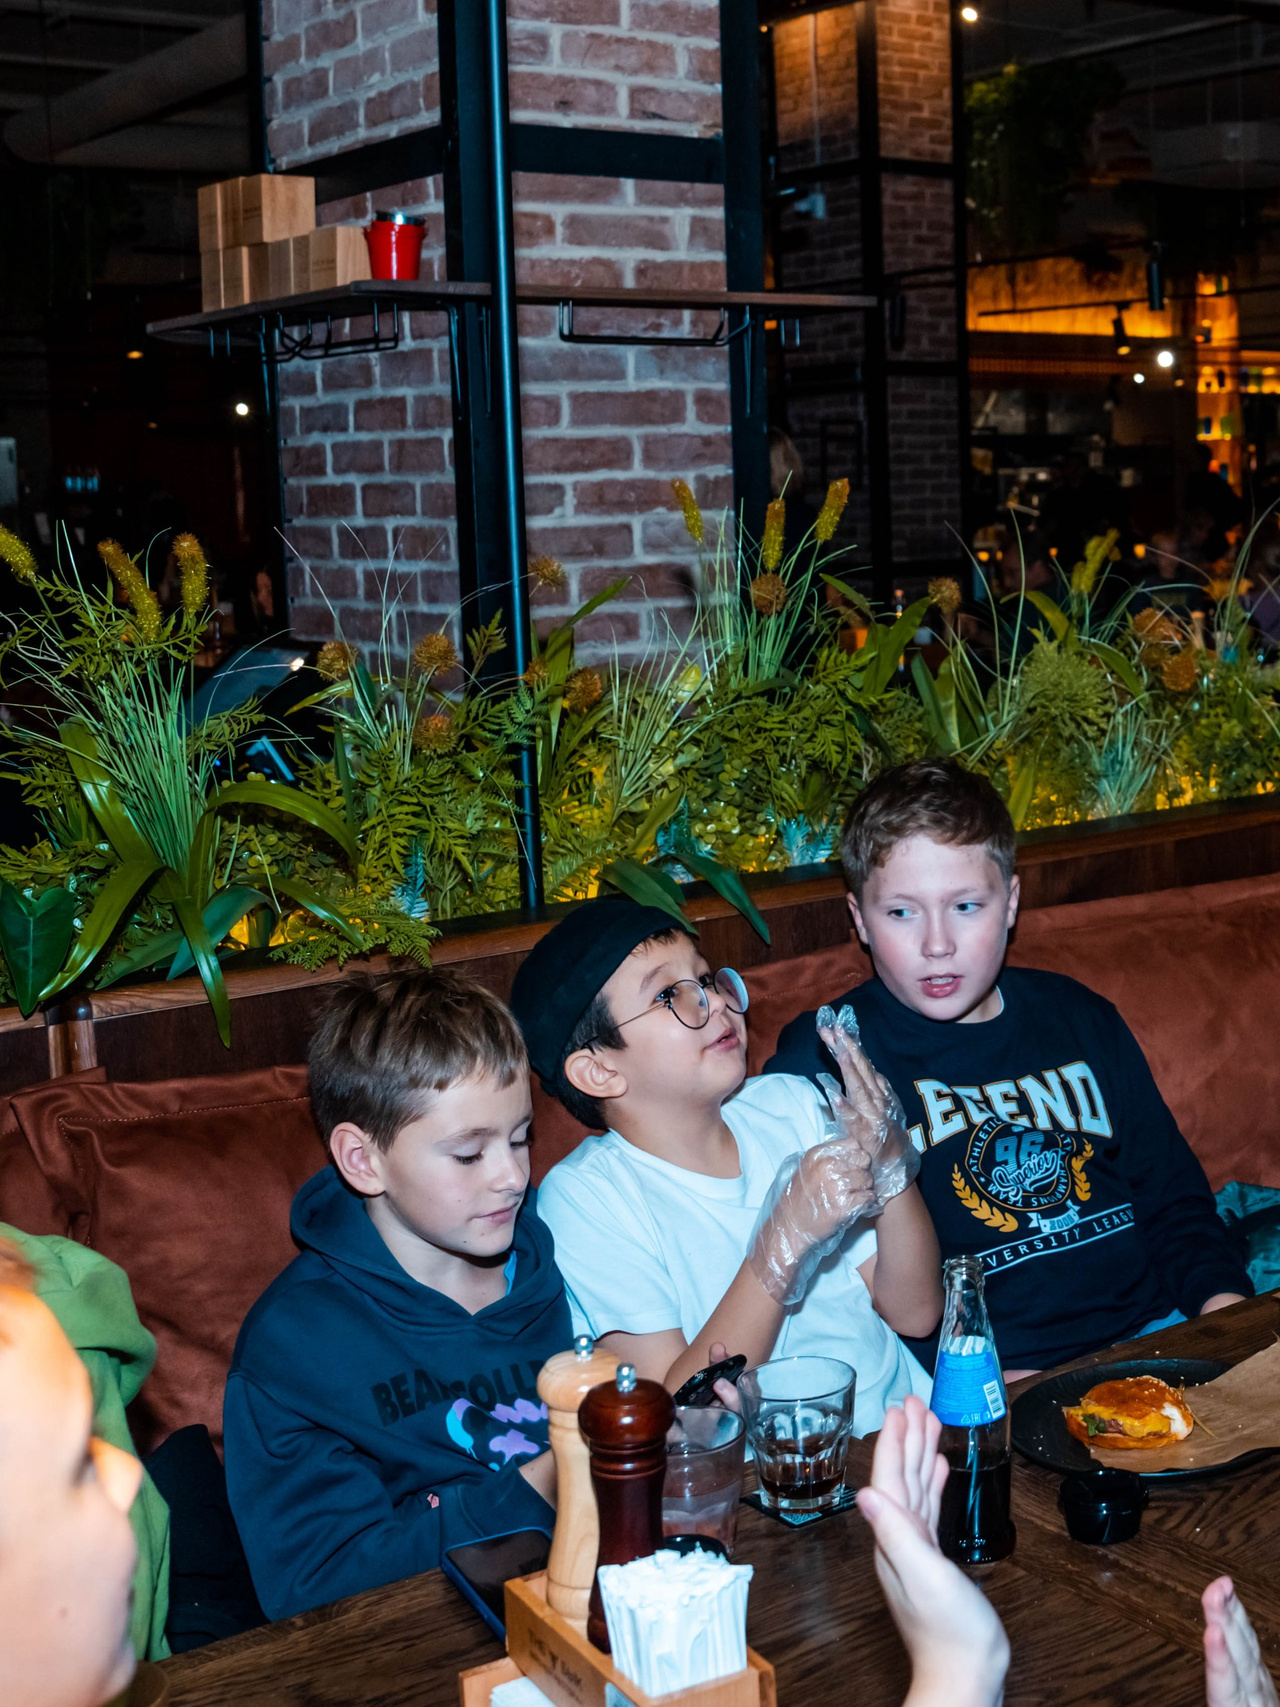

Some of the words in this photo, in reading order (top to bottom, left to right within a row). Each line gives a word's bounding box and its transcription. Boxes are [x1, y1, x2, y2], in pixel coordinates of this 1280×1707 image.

[992, 1148, 1062, 1200] Superior
[995, 1131, 1045, 1173] 96
[986, 1227, 1081, 1268] VERSITY
[1093, 1208, 1135, 1234] LEAGU
